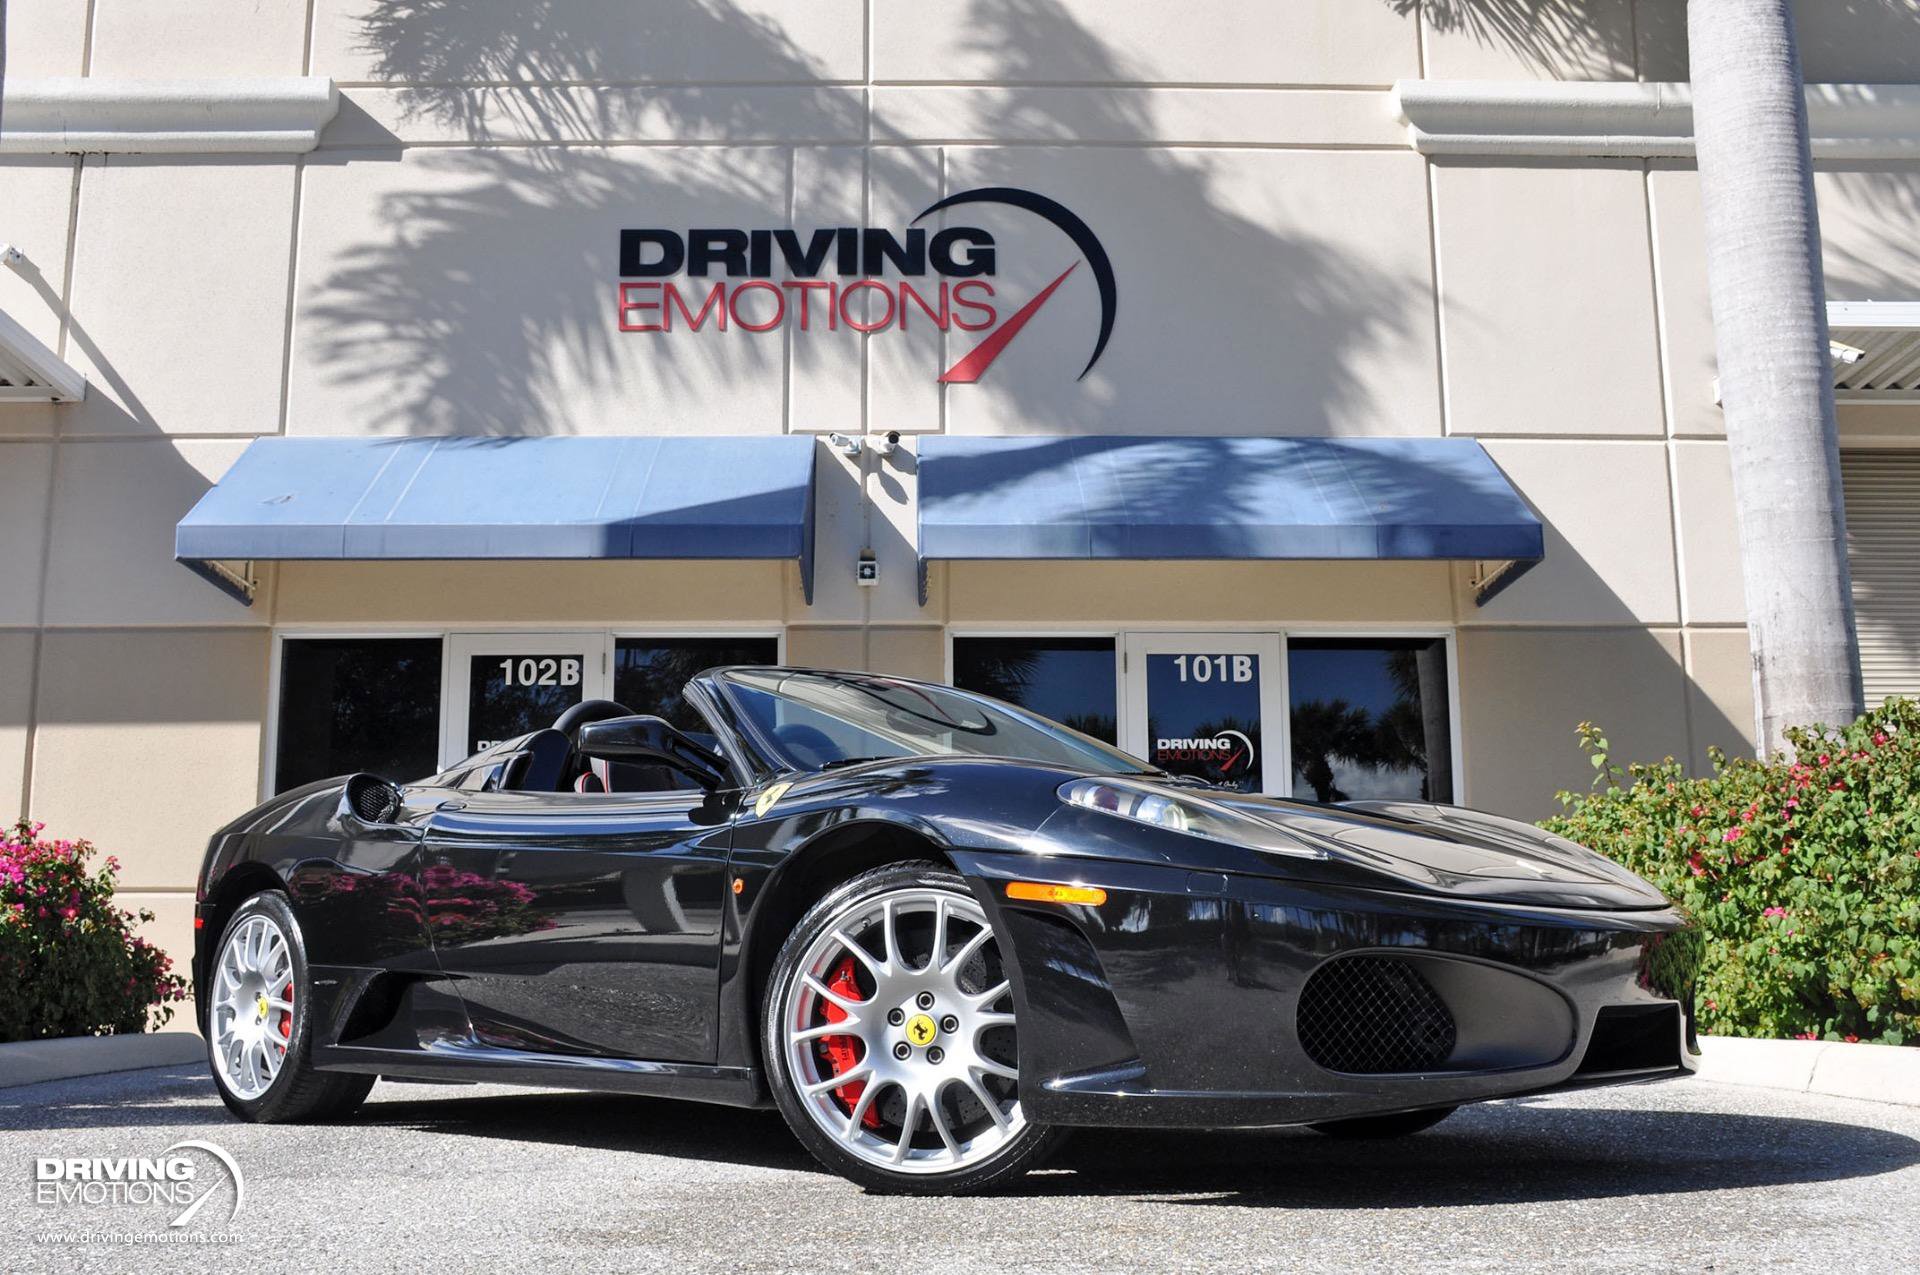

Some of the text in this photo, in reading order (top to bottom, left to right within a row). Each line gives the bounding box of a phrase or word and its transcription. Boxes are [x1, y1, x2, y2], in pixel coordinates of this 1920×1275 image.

[619, 227, 996, 278] DRIVING
[618, 280, 998, 332] EMOTIONS
[500, 658, 580, 686] 102B
[1174, 655, 1252, 682] 101B
[1157, 738, 1231, 750] DRIVING
[1157, 750, 1232, 761] EMOTIONS
